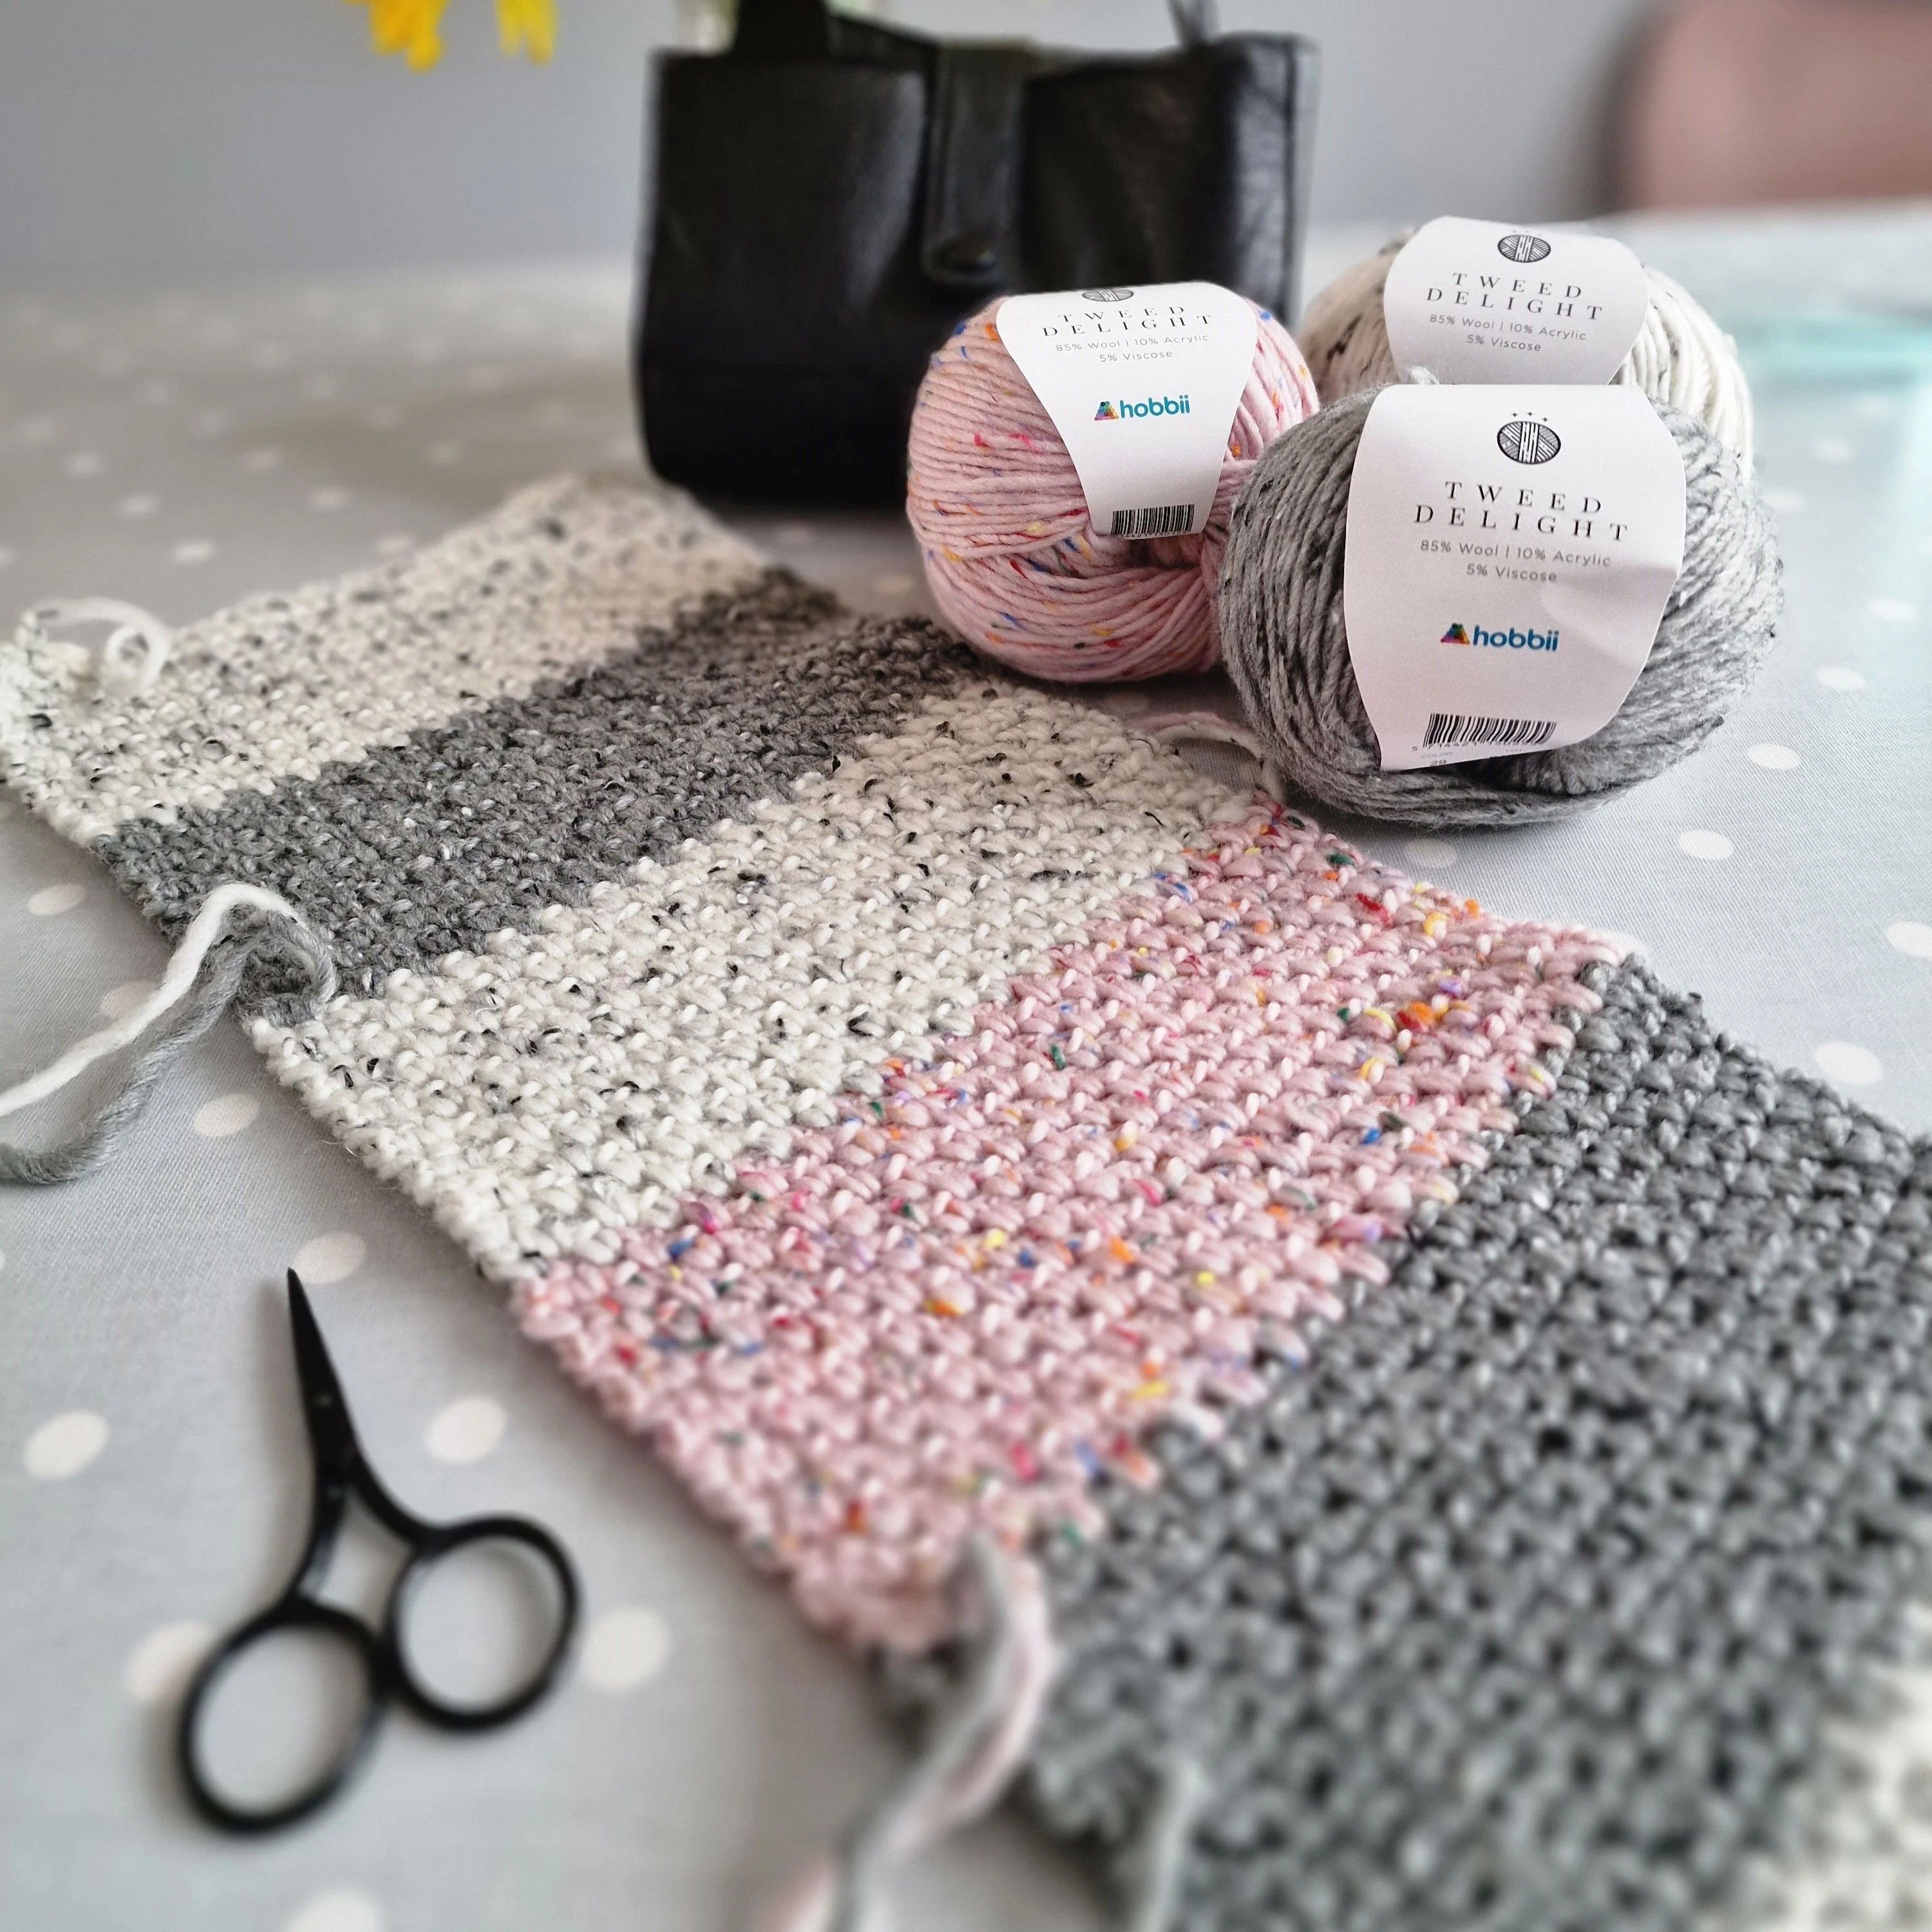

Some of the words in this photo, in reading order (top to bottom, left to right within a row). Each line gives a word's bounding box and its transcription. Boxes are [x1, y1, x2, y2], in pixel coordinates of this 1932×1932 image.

[1453, 272, 1582, 298] TWEED
[1057, 306, 1184, 322] TWEED
[1426, 288, 1603, 320] DELIGHT
[1042, 315, 1211, 337] DELIGHT
[1429, 314, 1456, 325] 85%
[1462, 317, 1495, 330] Wool
[1510, 323, 1533, 334] 10%
[1539, 327, 1587, 341] Acrylic
[1056, 343, 1082, 352] 85%
[1087, 340, 1120, 349] Wool
[1164, 335, 1209, 345] Acrylic
[1466, 334, 1484, 345] 5%
[1491, 337, 1541, 352] Viscose
[1099, 354, 1117, 363] 5%
[1122, 350, 1173, 361] Viscose
[1119, 394, 1191, 419] hobbii
[1444, 480, 1602, 514] TWEED
[1414, 504, 1627, 542] DELIGHT
[1420, 540, 1452, 553] 85%
[1459, 542, 1499, 556] Wool
[1517, 547, 1546, 560] 10%
[1553, 550, 1611, 567] Acrylic
[1466, 563, 1488, 577] 5%
[1495, 565, 1557, 583] Viscose
[1473, 625, 1559, 652] hobbii
